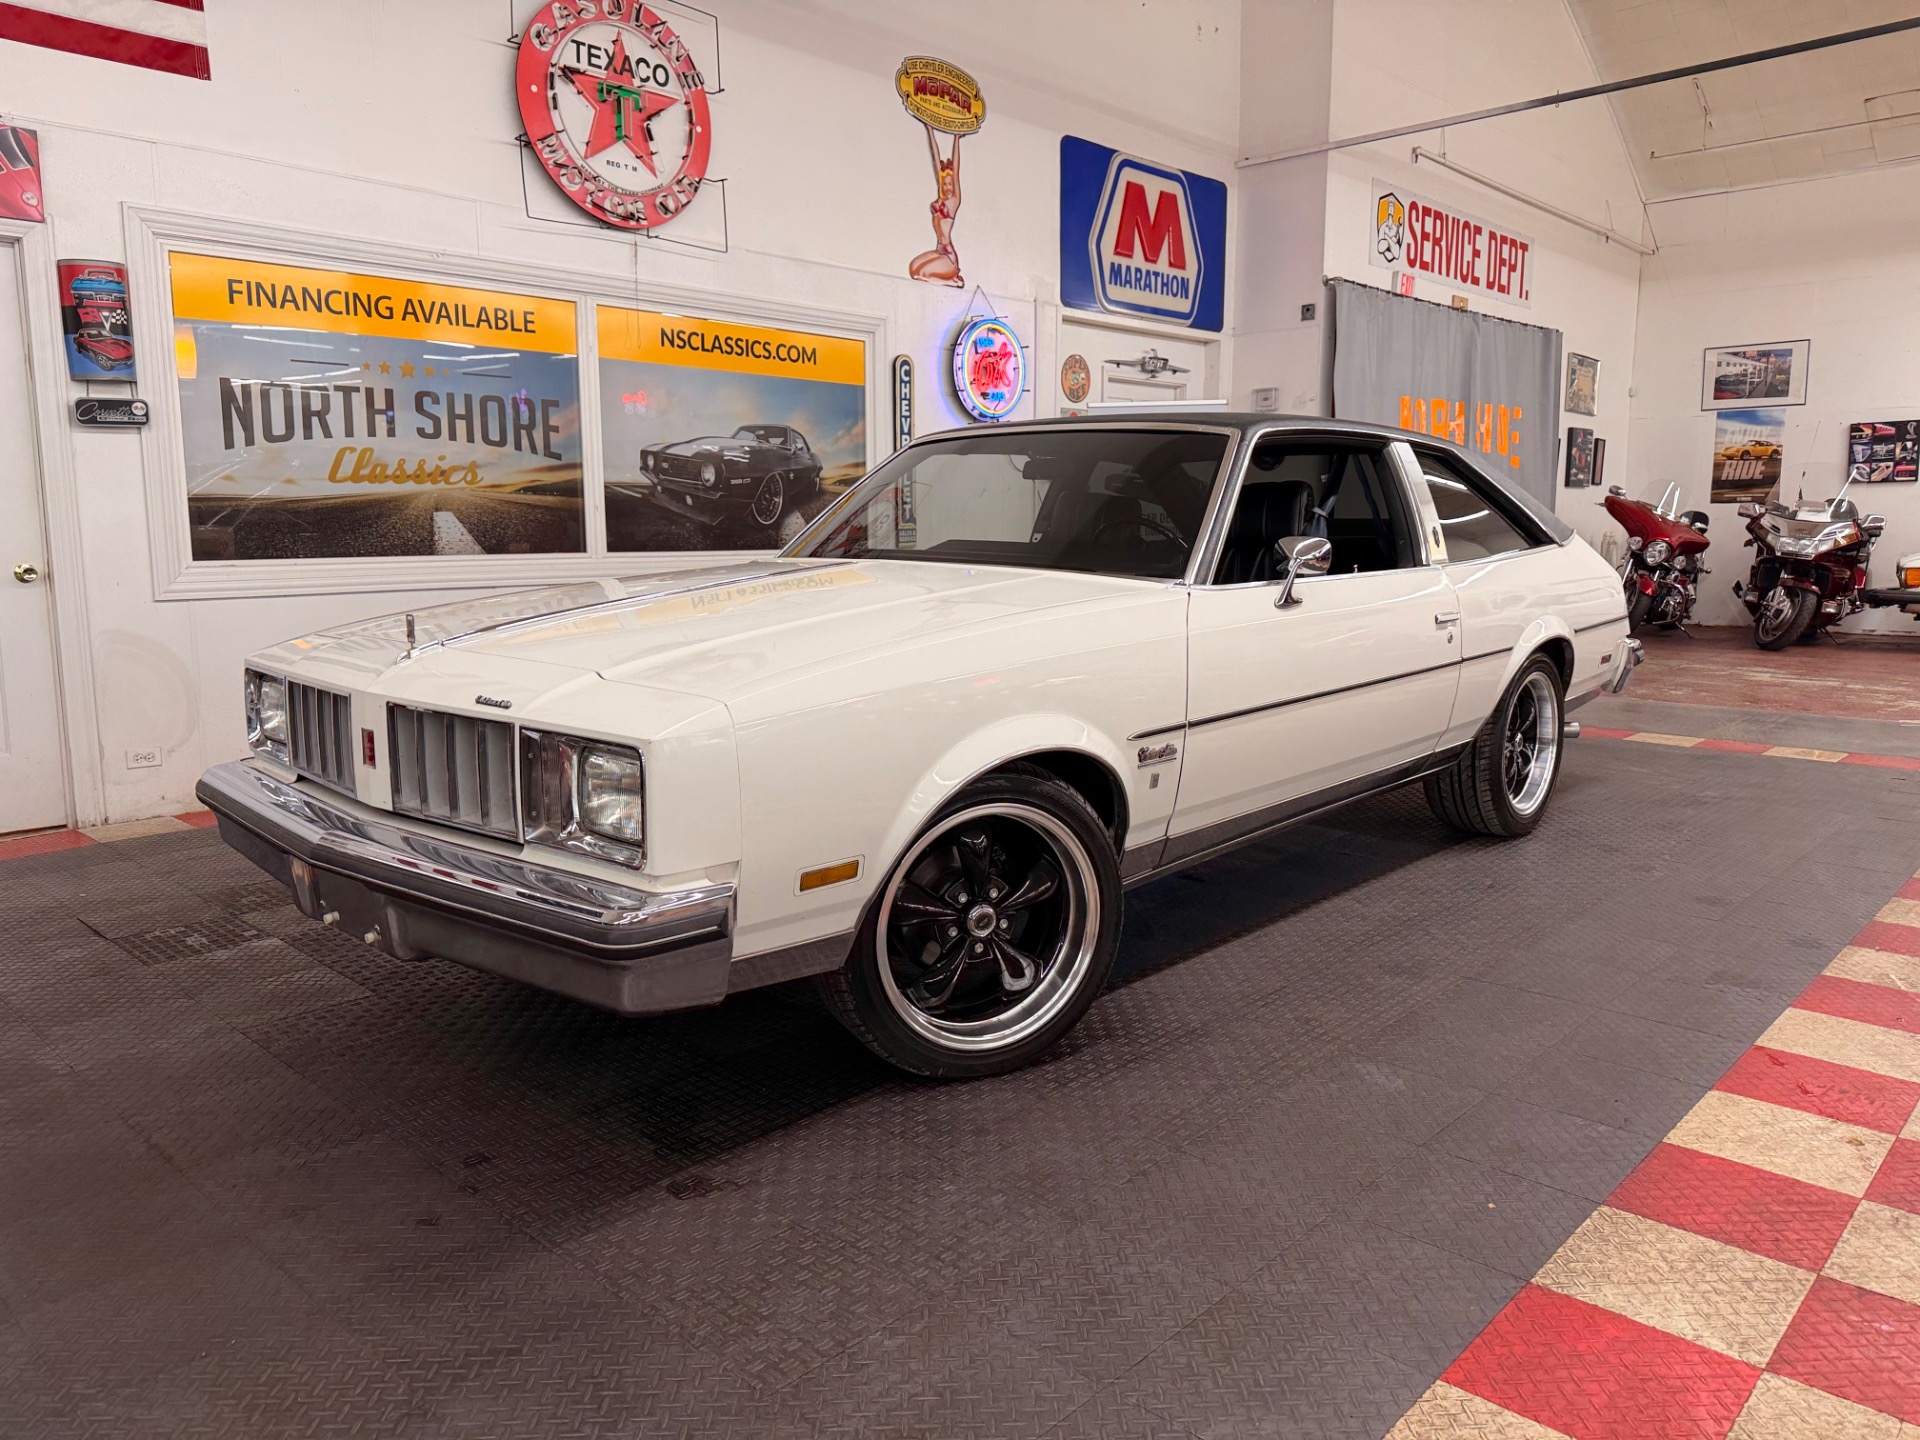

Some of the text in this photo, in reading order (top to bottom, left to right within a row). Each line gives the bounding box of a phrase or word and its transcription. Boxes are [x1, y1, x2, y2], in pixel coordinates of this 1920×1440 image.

[570, 39, 669, 87] TEXACO
[1113, 180, 1187, 271] M
[1406, 200, 1529, 301] SERVICE DEPT.
[1109, 262, 1190, 300] MARATHON
[1401, 273, 1416, 296] EXIT
[227, 278, 537, 334] FINANCING AVAILABLE
[660, 327, 818, 366] NSCLASSICS.COM
[77, 402, 133, 420] Corvette
[1068, 383, 1087, 401] BEE
[219, 377, 562, 461] NORTH SHORE
[328, 446, 484, 487] Classics
[1721, 460, 1767, 480] RIDE
